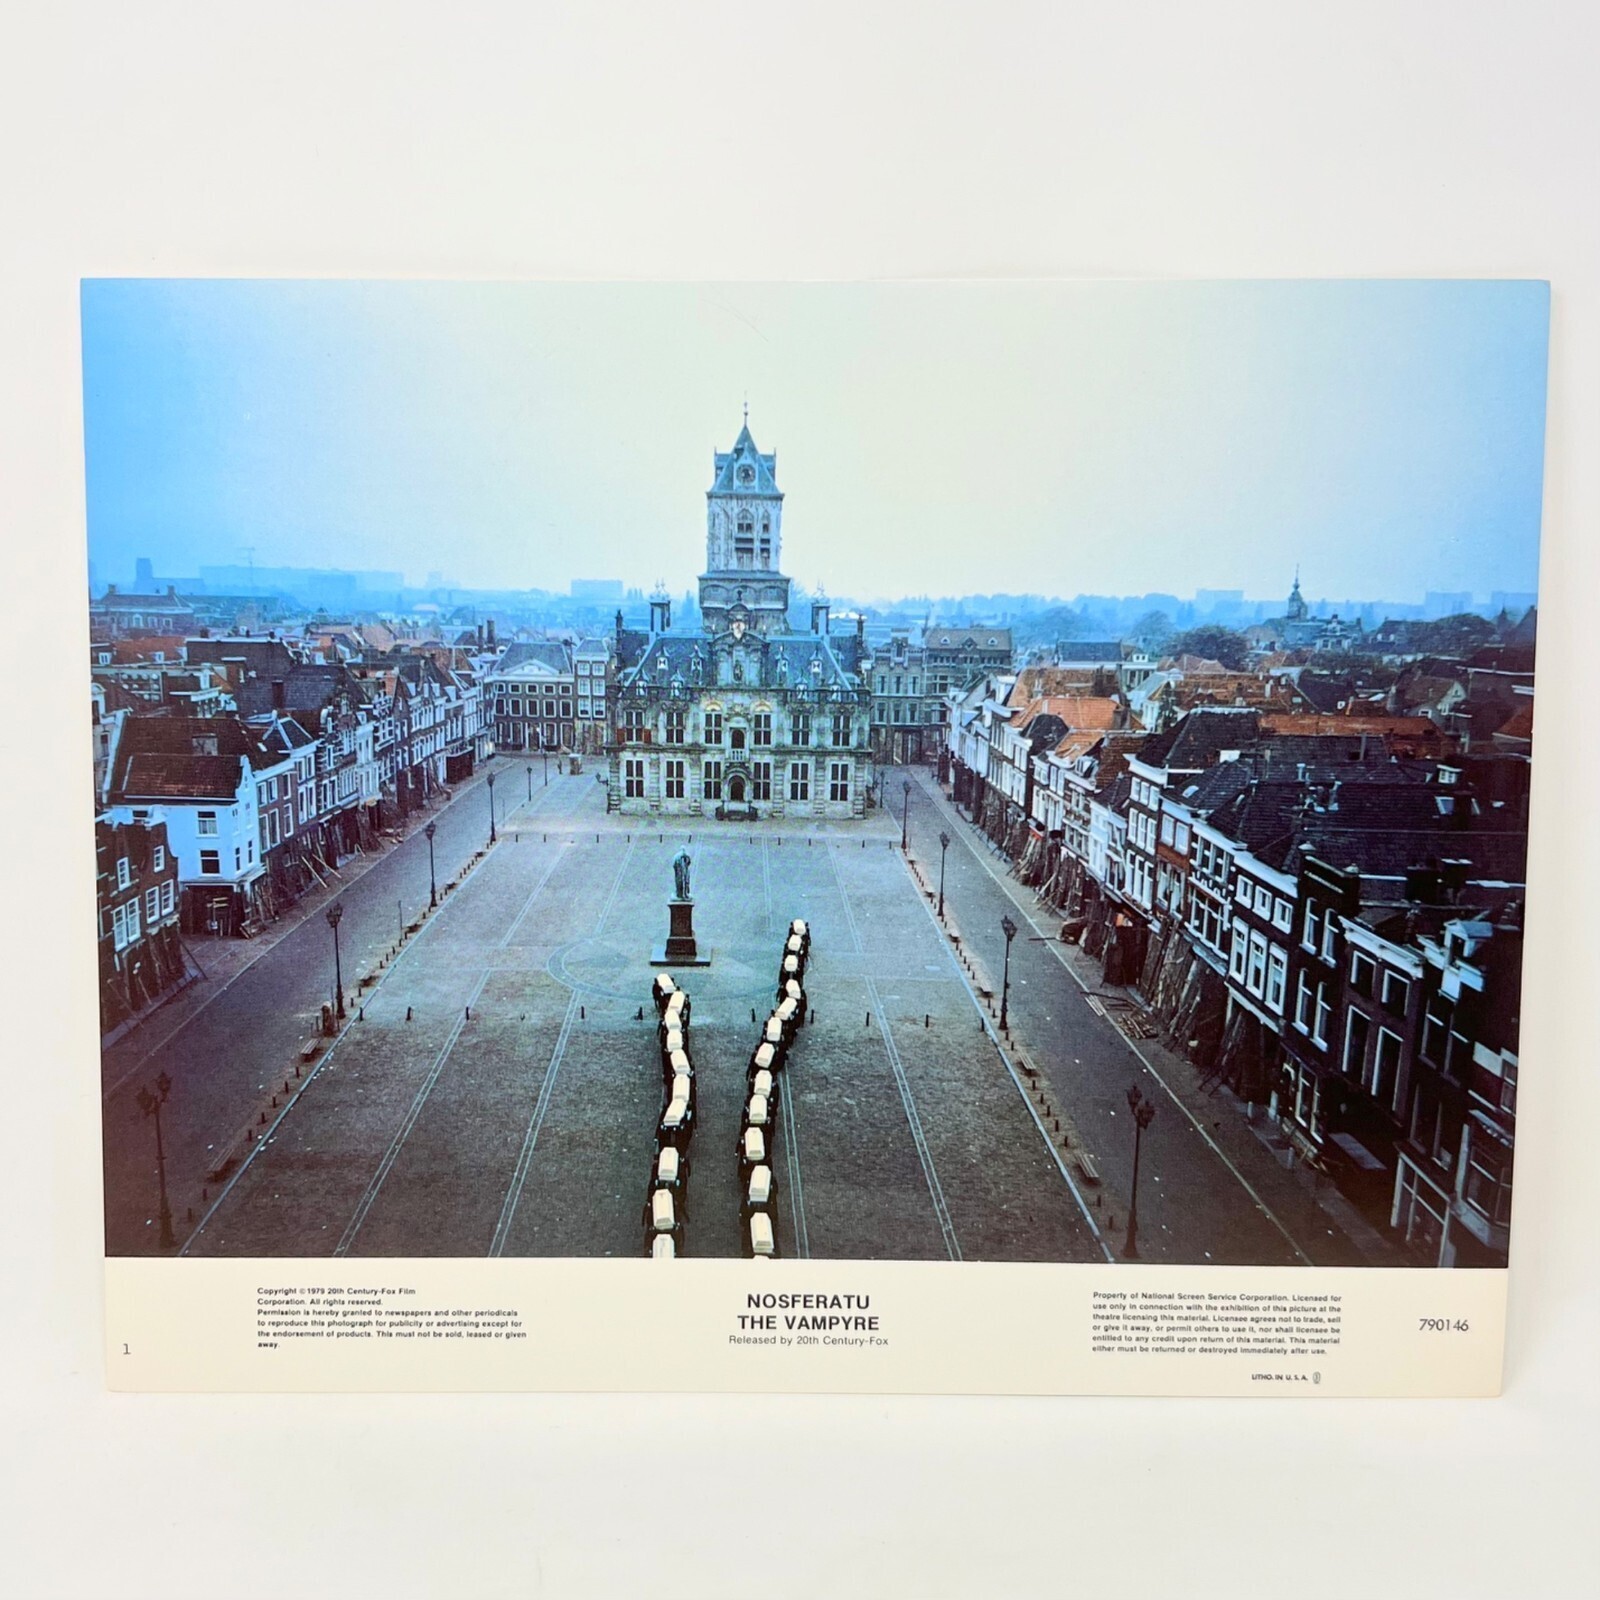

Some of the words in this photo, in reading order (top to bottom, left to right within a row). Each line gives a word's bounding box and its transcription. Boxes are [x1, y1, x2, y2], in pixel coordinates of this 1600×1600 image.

[257, 1287, 297, 1296] Copyright
[347, 1287, 396, 1296] Century-Fox
[1093, 1291, 1127, 1301] Property
[1141, 1292, 1175, 1300] National
[1177, 1292, 1205, 1300] Screen
[1207, 1293, 1237, 1301] Service
[1292, 1294, 1328, 1302] Licensed
[322, 1298, 345, 1307] rights
[747, 1293, 870, 1310] NOSFERATU
[257, 1308, 301, 1316] Permission
[312, 1309, 340, 1317] hereby
[342, 1309, 372, 1318] granted
[385, 1310, 432, 1318] newspapers
[434, 1309, 449, 1317] and
[474, 1309, 518, 1318] periodicals
[1109, 1303, 1127, 1311] only
[1139, 1303, 1184, 1311] connection
[1220, 1304, 1260, 1312] exhibition
[1289, 1305, 1317, 1314] picture
[268, 1319, 309, 1328] reproduce
[327, 1320, 373, 1328] photograph
[389, 1320, 423, 1328] publicity
[436, 1320, 480, 1329] advertising
[482, 1320, 509, 1328] except
[737, 1315, 777, 1330] THE
[784, 1315, 879, 1331] VAMPYRE
[1092, 1313, 1121, 1321] theatre
[1122, 1313, 1158, 1323] licensing
[1176, 1314, 1210, 1322] material.
[1250, 1316, 1277, 1324] agrees
[1303, 1316, 1326, 1324] trade,
[1103, 1324, 1120, 1333] give
[1130, 1325, 1153, 1333] away,
[1166, 1325, 1192, 1333] permit
[1194, 1325, 1219, 1333] others
[1295, 1326, 1329, 1334] licensee
[1419, 1318, 1469, 1332] 790146
[272, 1330, 324, 1338] endorsement
[326, 1330, 335, 1338] of
[376, 1330, 393, 1338] This
[505, 1331, 527, 1340] given
[1092, 1334, 1122, 1342] entitled
[1135, 1336, 1149, 1344] any
[1177, 1336, 1198, 1344] upon
[729, 1335, 777, 1345] Released
[780, 1336, 793, 1347] by
[796, 1335, 819, 1345] 20th
[822, 1335, 889, 1348] Century-Fox
[123, 1343, 131, 1355] 1
[1139, 1345, 1149, 1353] be
[1198, 1346, 1238, 1355] destroyed
[1240, 1346, 1288, 1356] immediately
